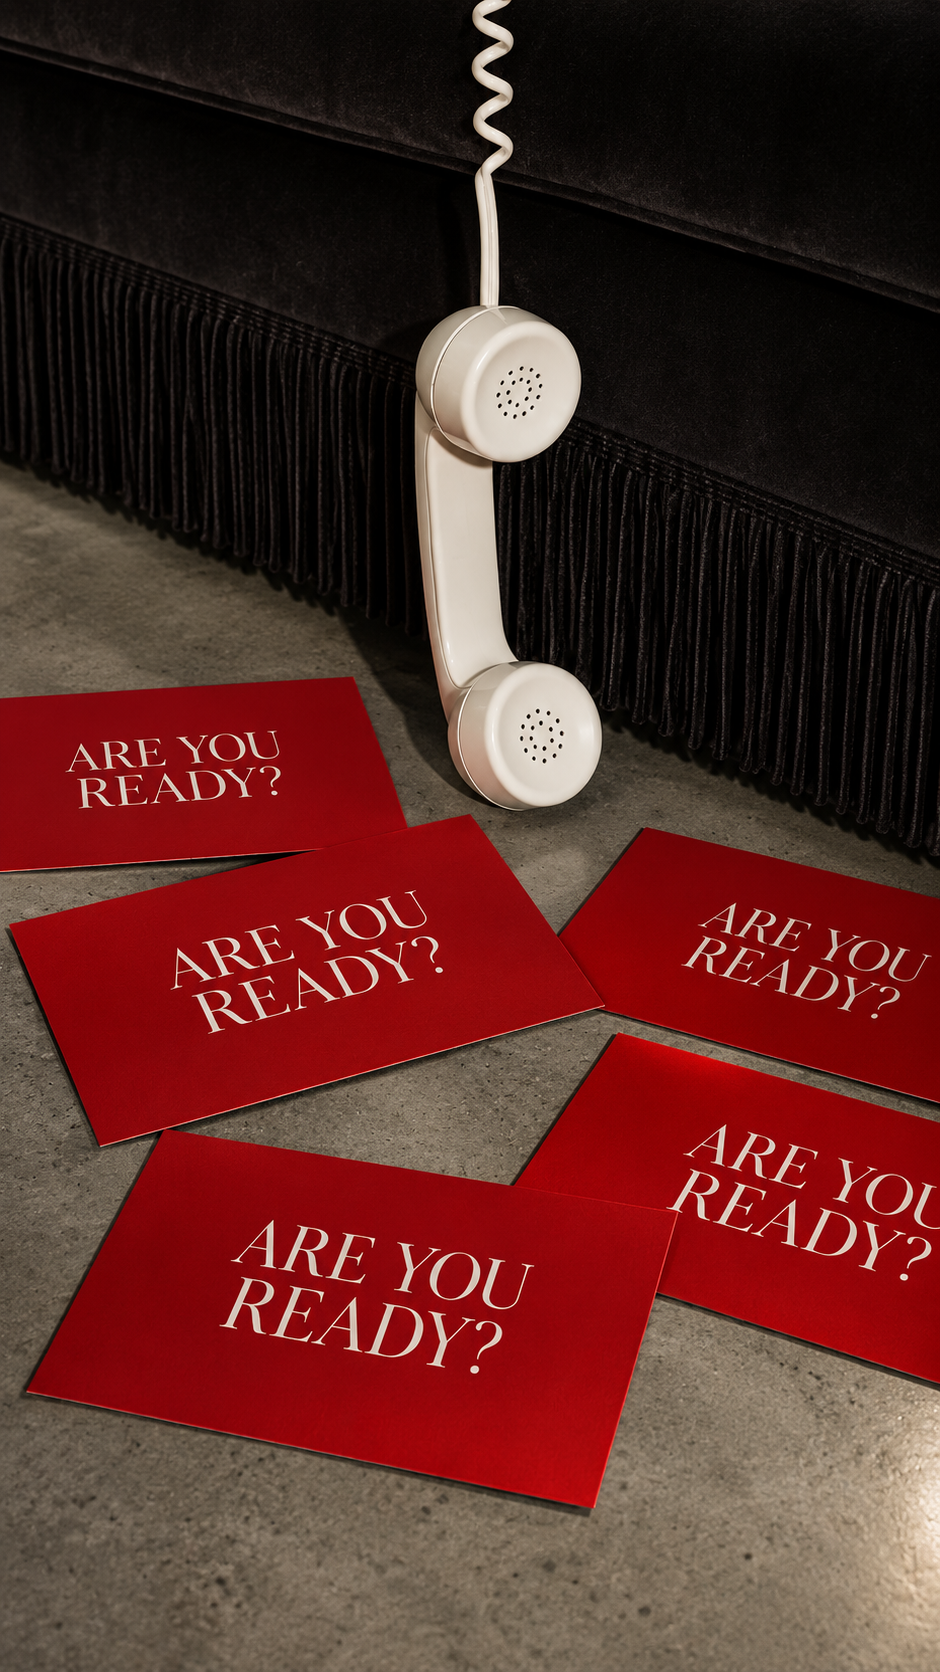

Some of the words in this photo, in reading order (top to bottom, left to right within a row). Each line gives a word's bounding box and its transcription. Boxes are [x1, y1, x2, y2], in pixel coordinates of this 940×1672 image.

[66, 738, 168, 774] ARE
[176, 729, 280, 765] YOU
[77, 765, 283, 810] READY?
[170, 924, 296, 992] ARE
[295, 888, 430, 950] YOU
[682, 934, 902, 1021] READY?
[698, 902, 812, 952] ARE
[821, 928, 931, 983] YOU
[191, 934, 445, 1036] READY?
[683, 1123, 819, 1190] ARE
[230, 1219, 376, 1286] ARE
[393, 1240, 535, 1311] YOU
[665, 1168, 932, 1282] READY?
[219, 1276, 504, 1376] READY?
